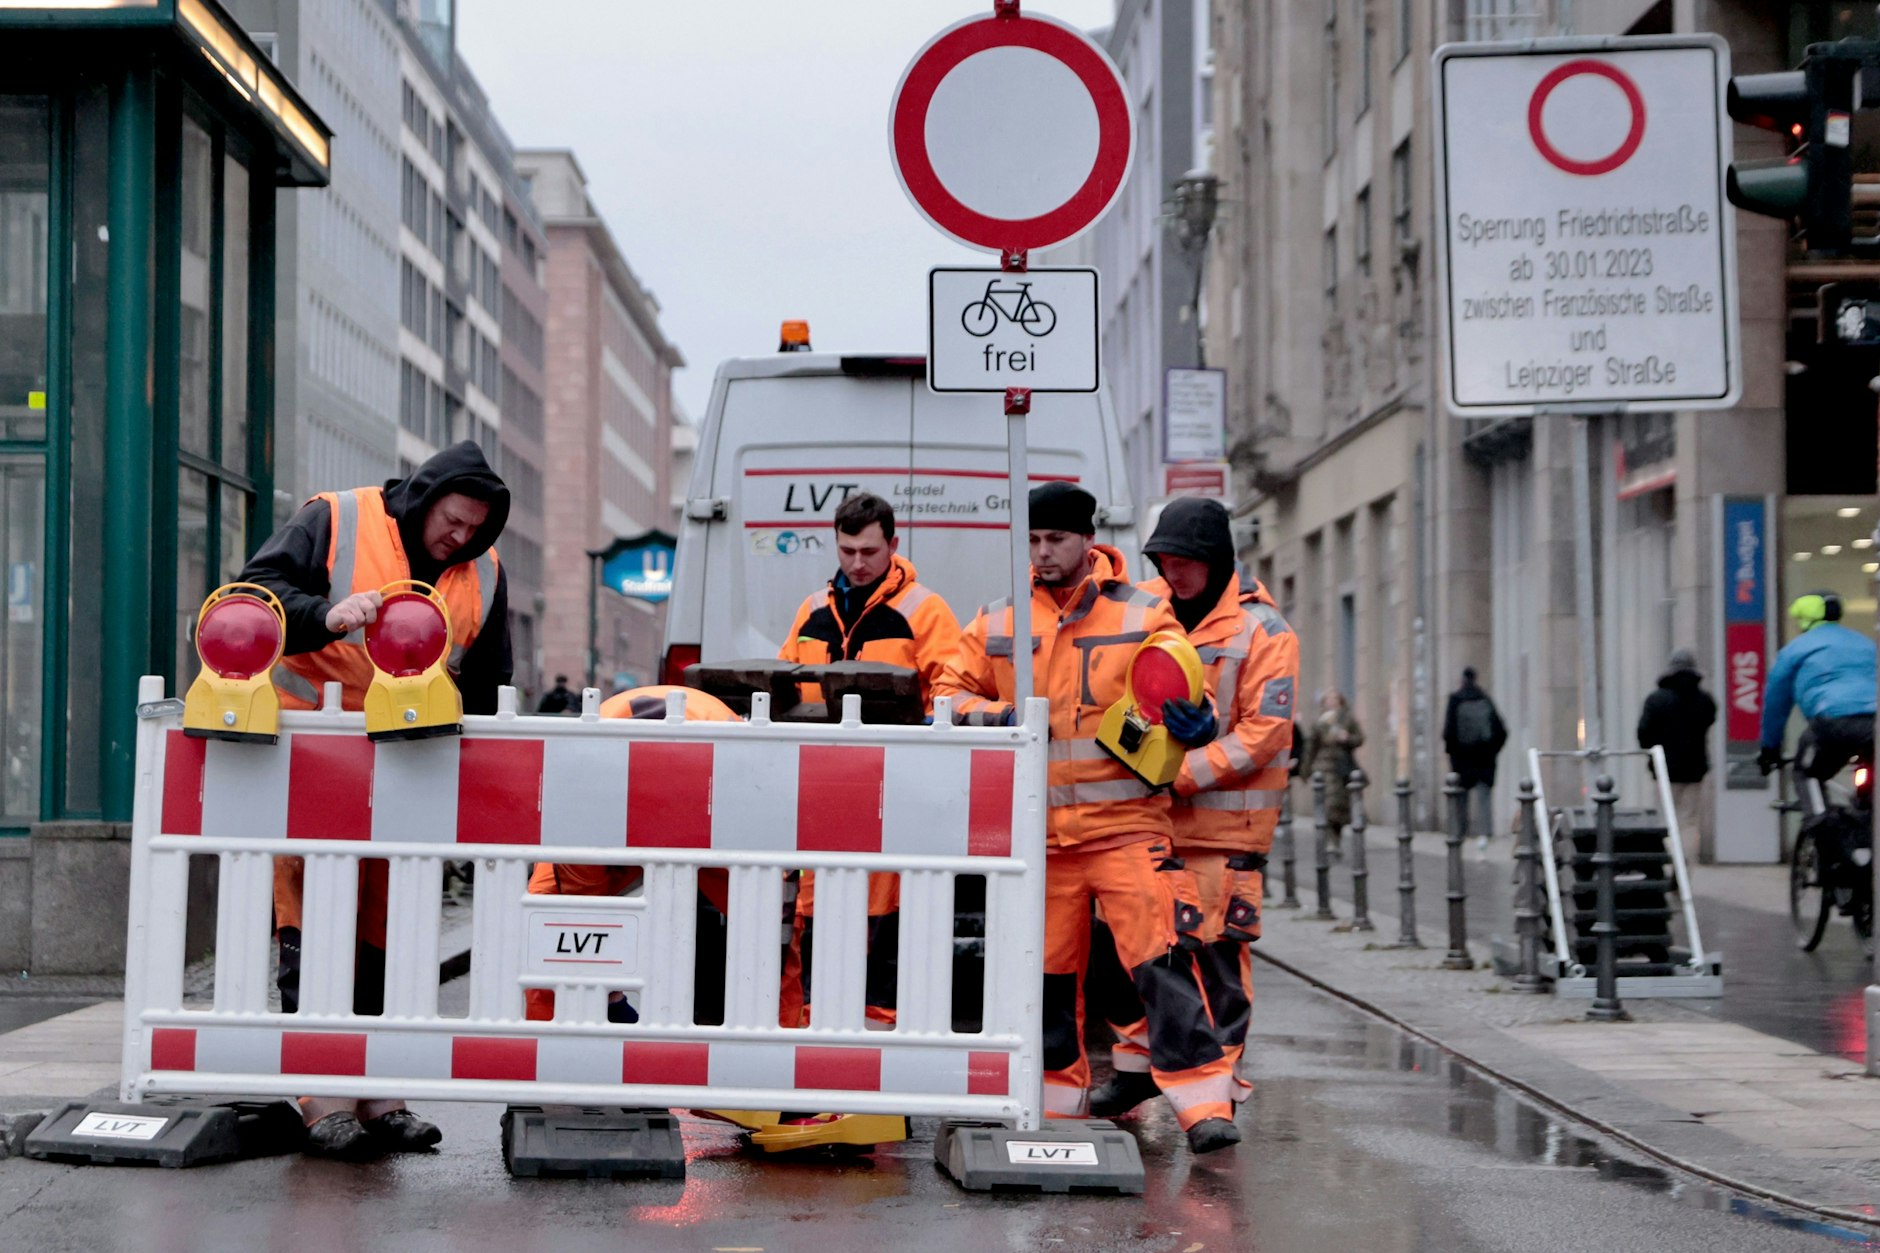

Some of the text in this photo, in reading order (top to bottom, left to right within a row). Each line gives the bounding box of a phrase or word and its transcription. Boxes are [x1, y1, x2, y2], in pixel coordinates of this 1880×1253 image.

[1457, 204, 1709, 246] Sperrung Friedrichstraße
[1509, 249, 1654, 281] ab 30.01.2023
[1463, 283, 1714, 320] zwischen Französische Straße
[1570, 323, 1607, 352] und
[983, 343, 1036, 372] frei
[1505, 355, 1677, 395] Leipziger Straße
[893, 483, 945, 497] Lendel
[1732, 650, 1760, 715] AVIS
[556, 932, 609, 954] LVT
[93, 1120, 147, 1133] LVT
[1027, 1147, 1077, 1159] LVT
